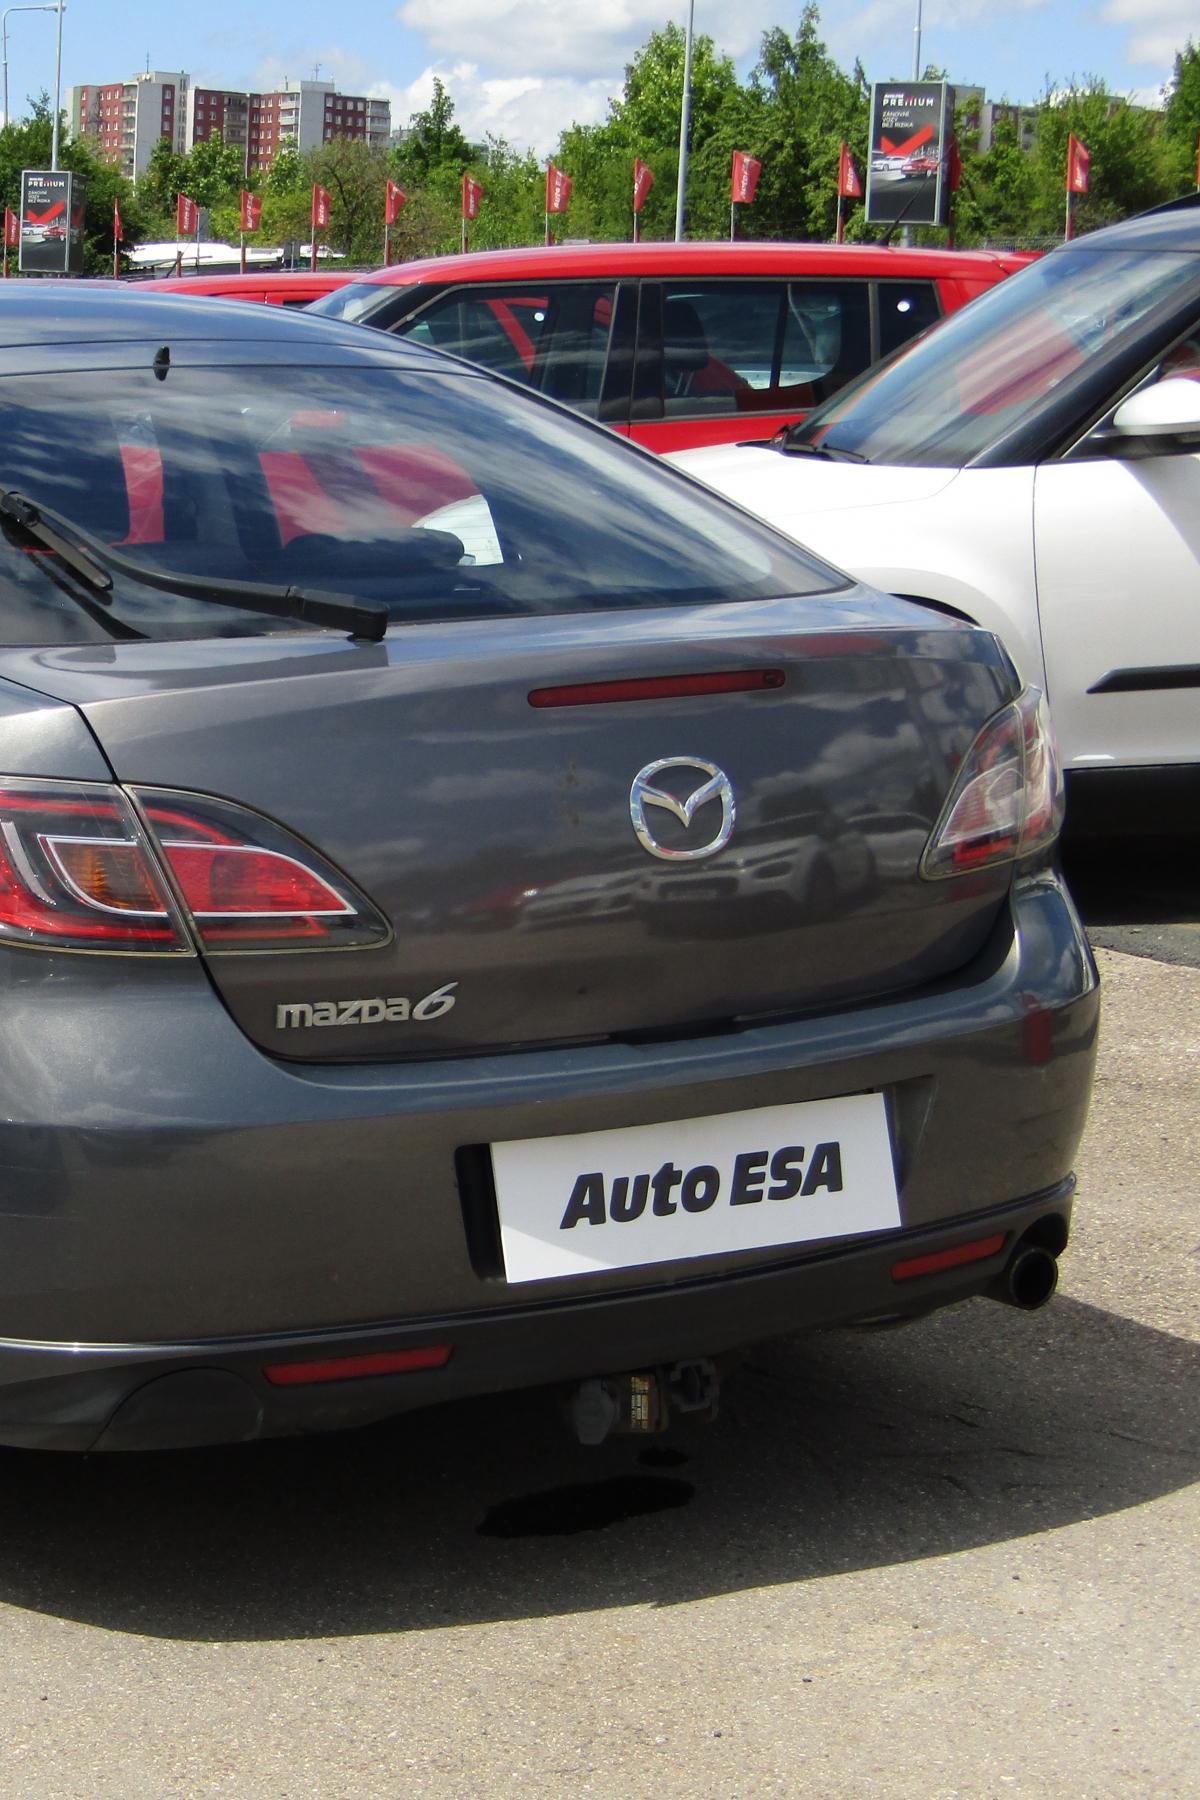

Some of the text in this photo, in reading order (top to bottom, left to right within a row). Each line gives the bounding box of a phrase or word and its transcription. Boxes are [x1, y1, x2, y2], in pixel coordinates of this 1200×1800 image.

[883, 97, 934, 106] PREMIUM
[559, 1141, 844, 1230] Auto ESA
